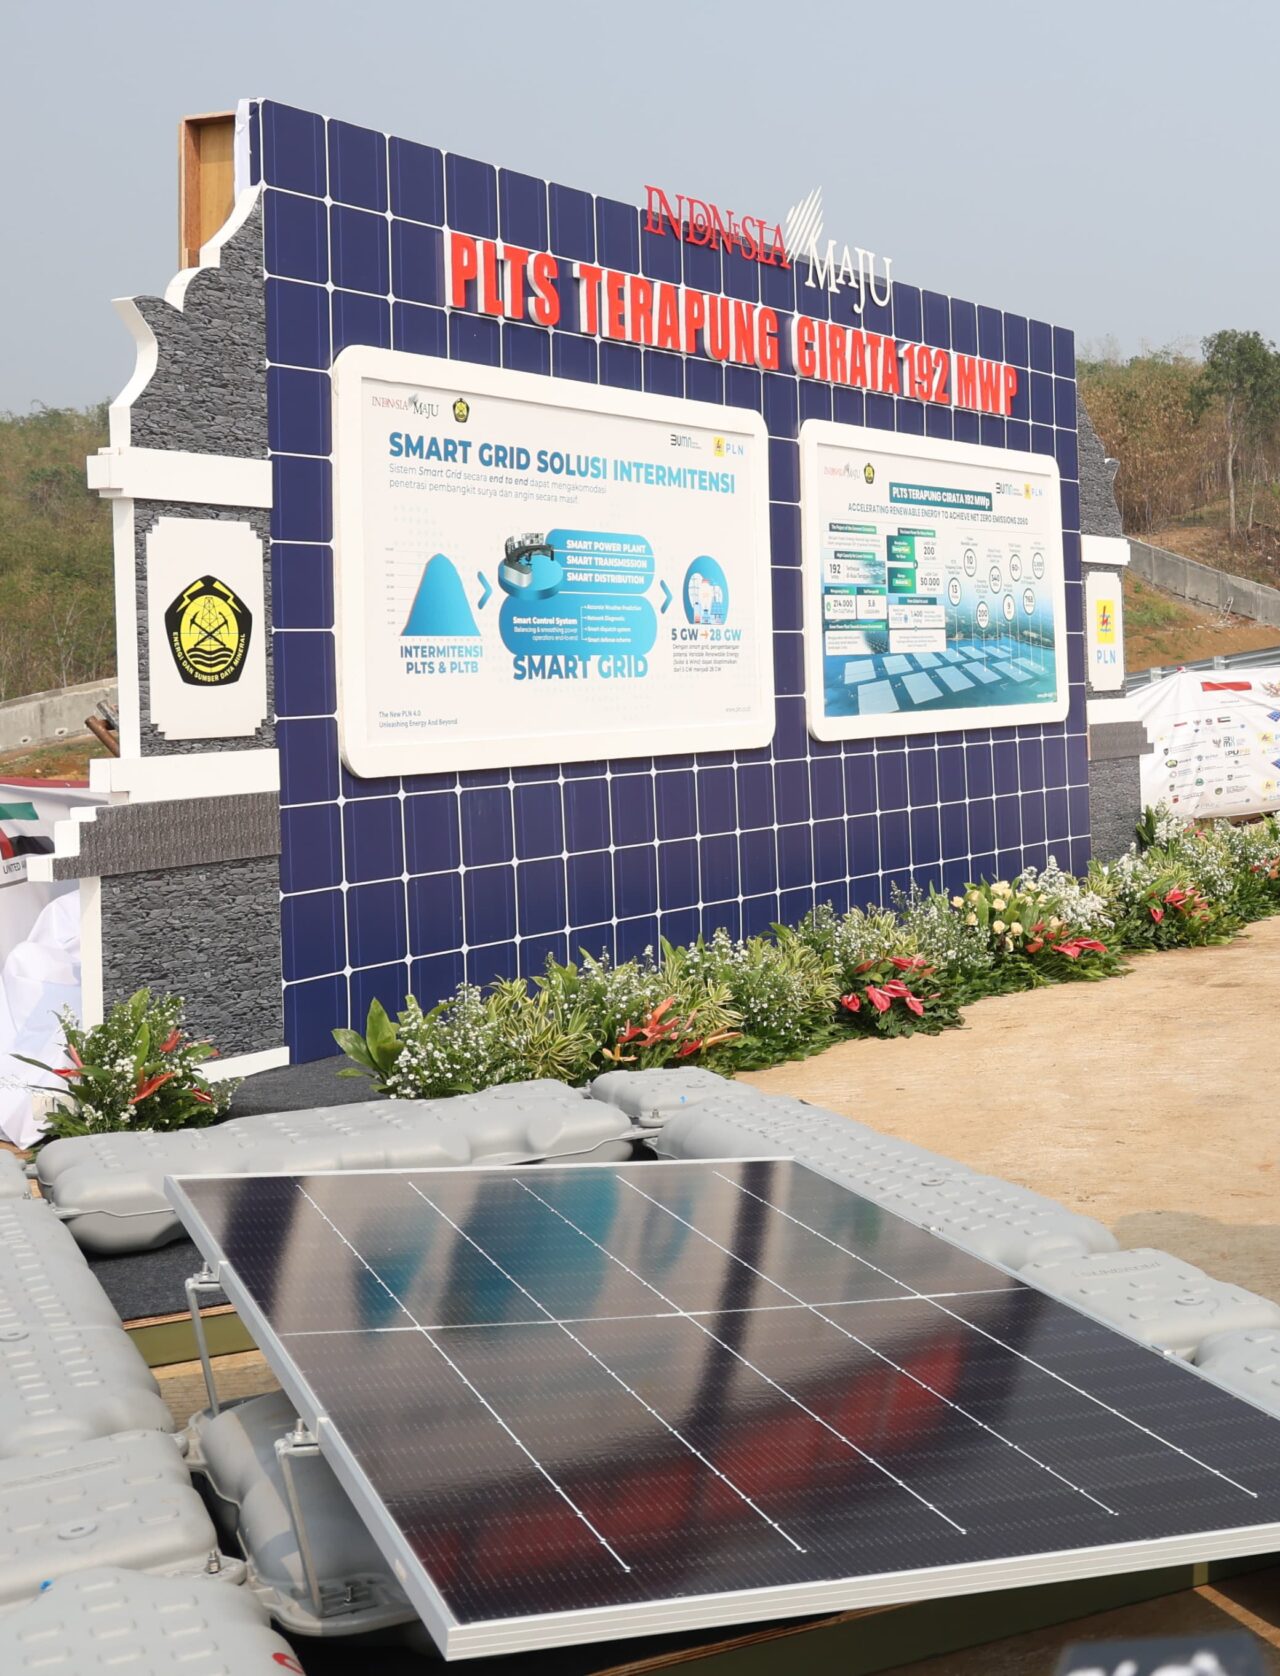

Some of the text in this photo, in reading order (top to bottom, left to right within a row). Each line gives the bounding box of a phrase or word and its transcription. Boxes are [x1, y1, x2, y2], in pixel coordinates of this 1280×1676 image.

[643, 184, 893, 315] INDONESIA MAJU
[446, 232, 1018, 416] PLTS TERAPUNG CIRATA 192 MWP
[726, 442, 744, 456] PLN
[389, 431, 736, 494] SMART GRID SOLUSI INTERMITENSI
[389, 463, 417, 474] Sistem
[418, 466, 443, 477] Smart
[445, 469, 462, 479] Grid
[463, 472, 488, 482] secara
[489, 474, 503, 484] end
[505, 476, 513, 484] to
[514, 477, 528, 486] end
[530, 479, 549, 488] dapat
[389, 479, 427, 490] penetrasi
[429, 483, 476, 496] pembangkit
[477, 487, 498, 498] surya
[499, 489, 513, 497] dan
[892, 487, 908, 499] PLTS
[908, 488, 941, 502] TERAPUNG
[942, 491, 965, 504] CIRATA
[965, 493, 975, 504] 192
[848, 502, 889, 514] ACCELERATING
[889, 506, 920, 517] RENEWABLE
[921, 508, 941, 519] ENERGY
[941, 511, 949, 519] TO
[566, 539, 646, 553] SMART POWER PLANT
[566, 555, 648, 568] SMART TRANSMISSION
[829, 563, 841, 574] 192
[567, 573, 645, 584] SMART DISTRIBUTION
[513, 616, 577, 627] Smart Control System
[671, 628, 741, 641] 5 GW 28 GW
[172, 631, 246, 682] ENERGI DAN SUMBER DAYA MINERAL
[400, 645, 483, 659] INTERMITENSI
[1096, 649, 1117, 664] PLN
[406, 660, 479, 675] PLTS & PLTB
[513, 654, 648, 681] SMART GRID
